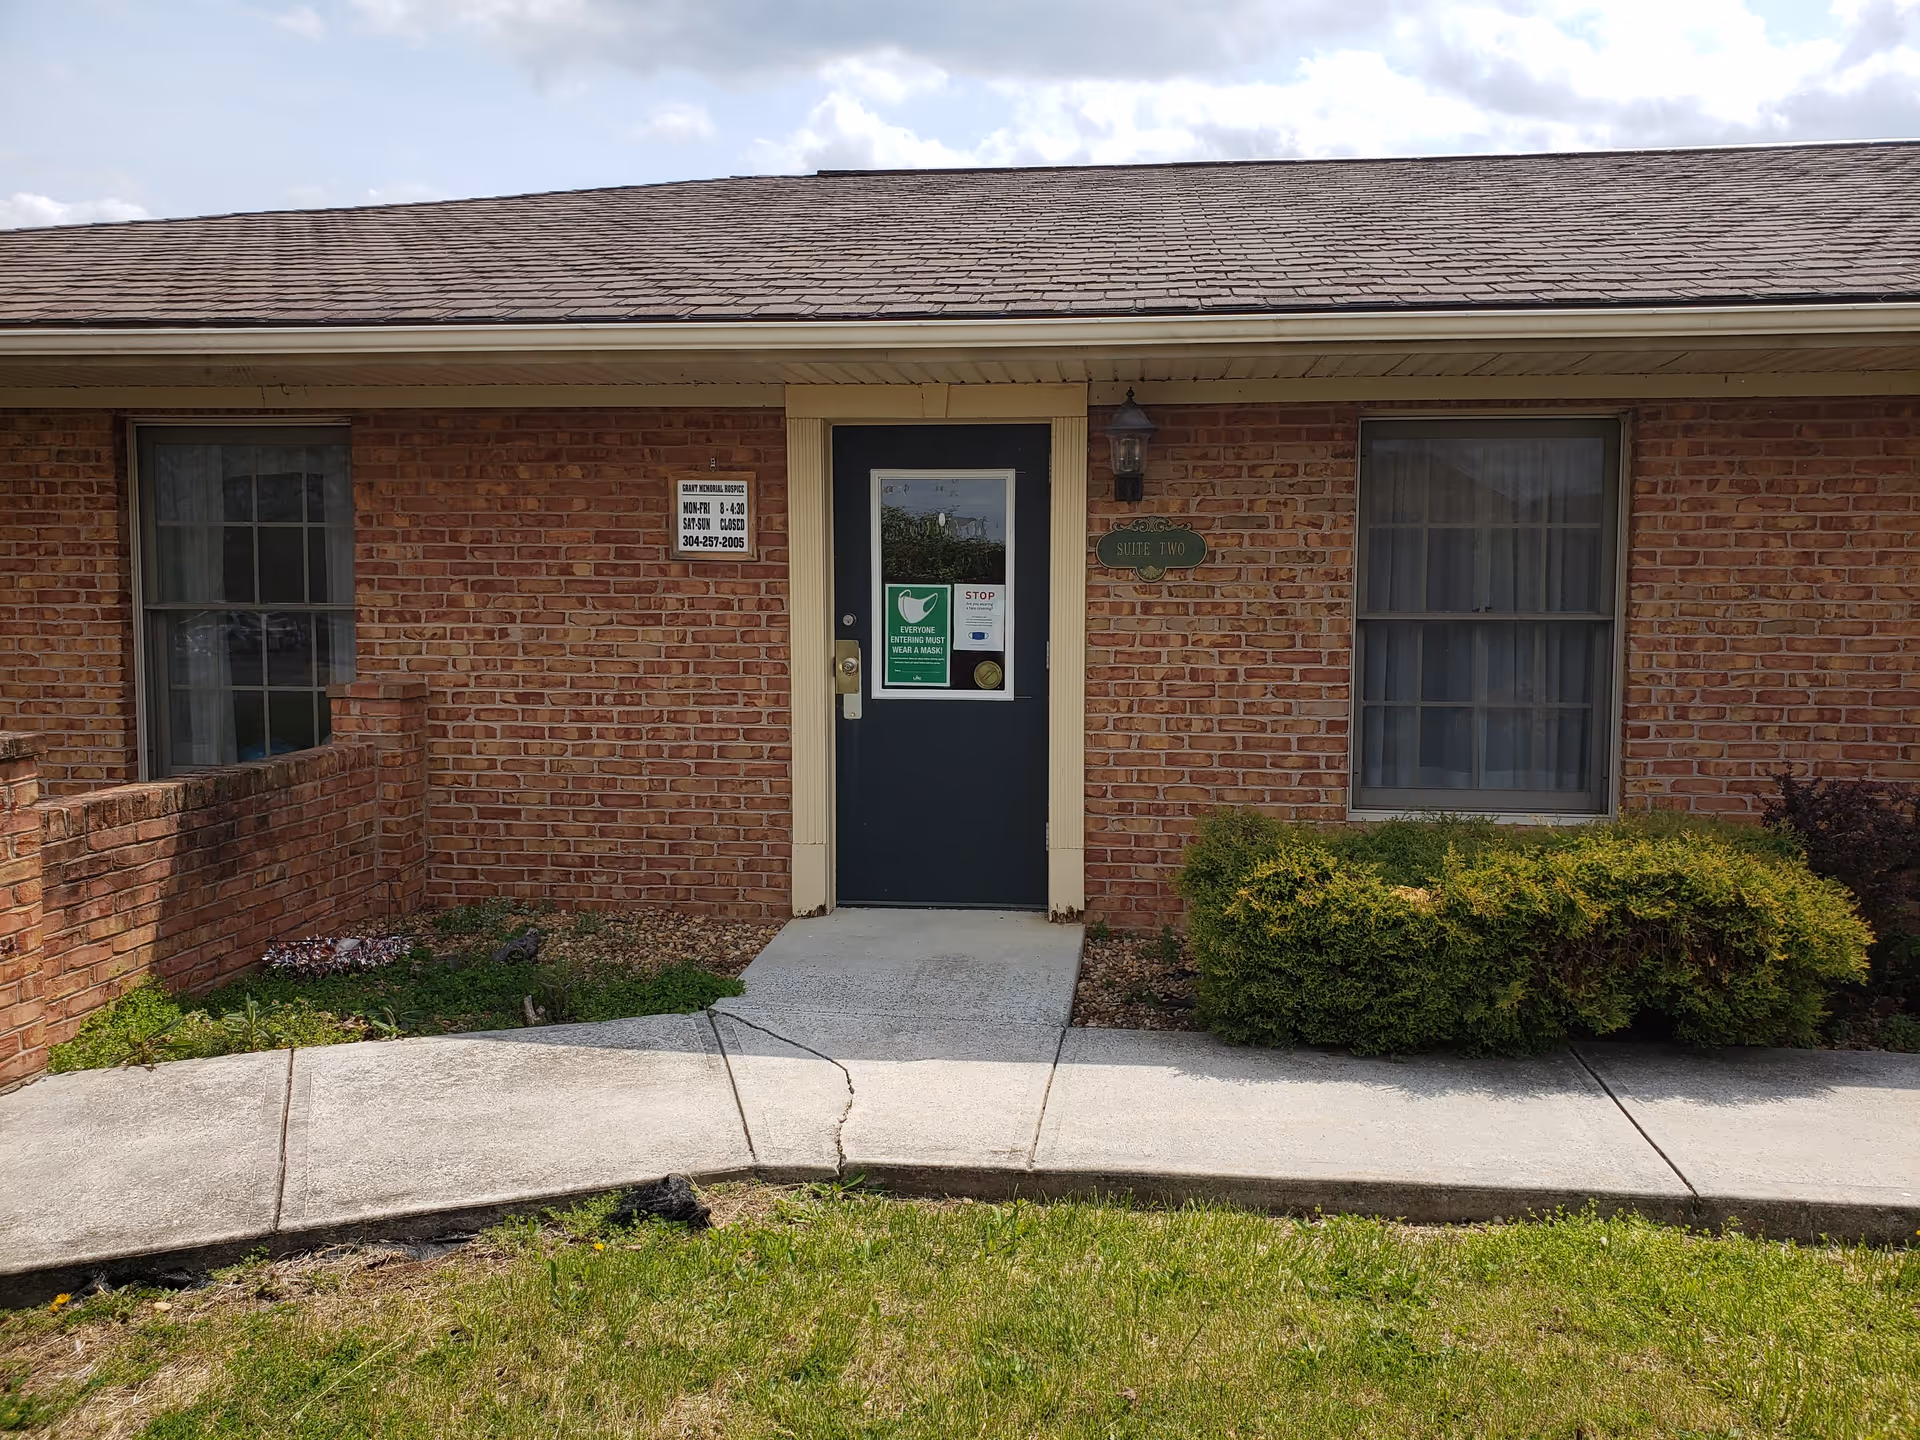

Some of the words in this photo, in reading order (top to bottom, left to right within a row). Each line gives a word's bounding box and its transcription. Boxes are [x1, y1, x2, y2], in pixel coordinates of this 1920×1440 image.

[682, 484, 698, 492] GRANT
[699, 485, 723, 493] MEMORIAL
[724, 485, 745, 493] HOSPICE
[682, 501, 711, 514] MON-FRI
[682, 517, 711, 530] SAT-SUN
[719, 518, 745, 531] CLOSED
[682, 535, 745, 548] 304-257-2005
[1117, 542, 1150, 556] SUITE
[1160, 542, 1185, 556] TWO
[965, 591, 995, 600] STOP
[900, 626, 935, 634] EVERYONE
[890, 635, 924, 644] ENTERING
[925, 636, 945, 644] MUST
[892, 646, 912, 654] WEAR
[913, 646, 919, 654] A
[920, 646, 943, 655] MASK!
